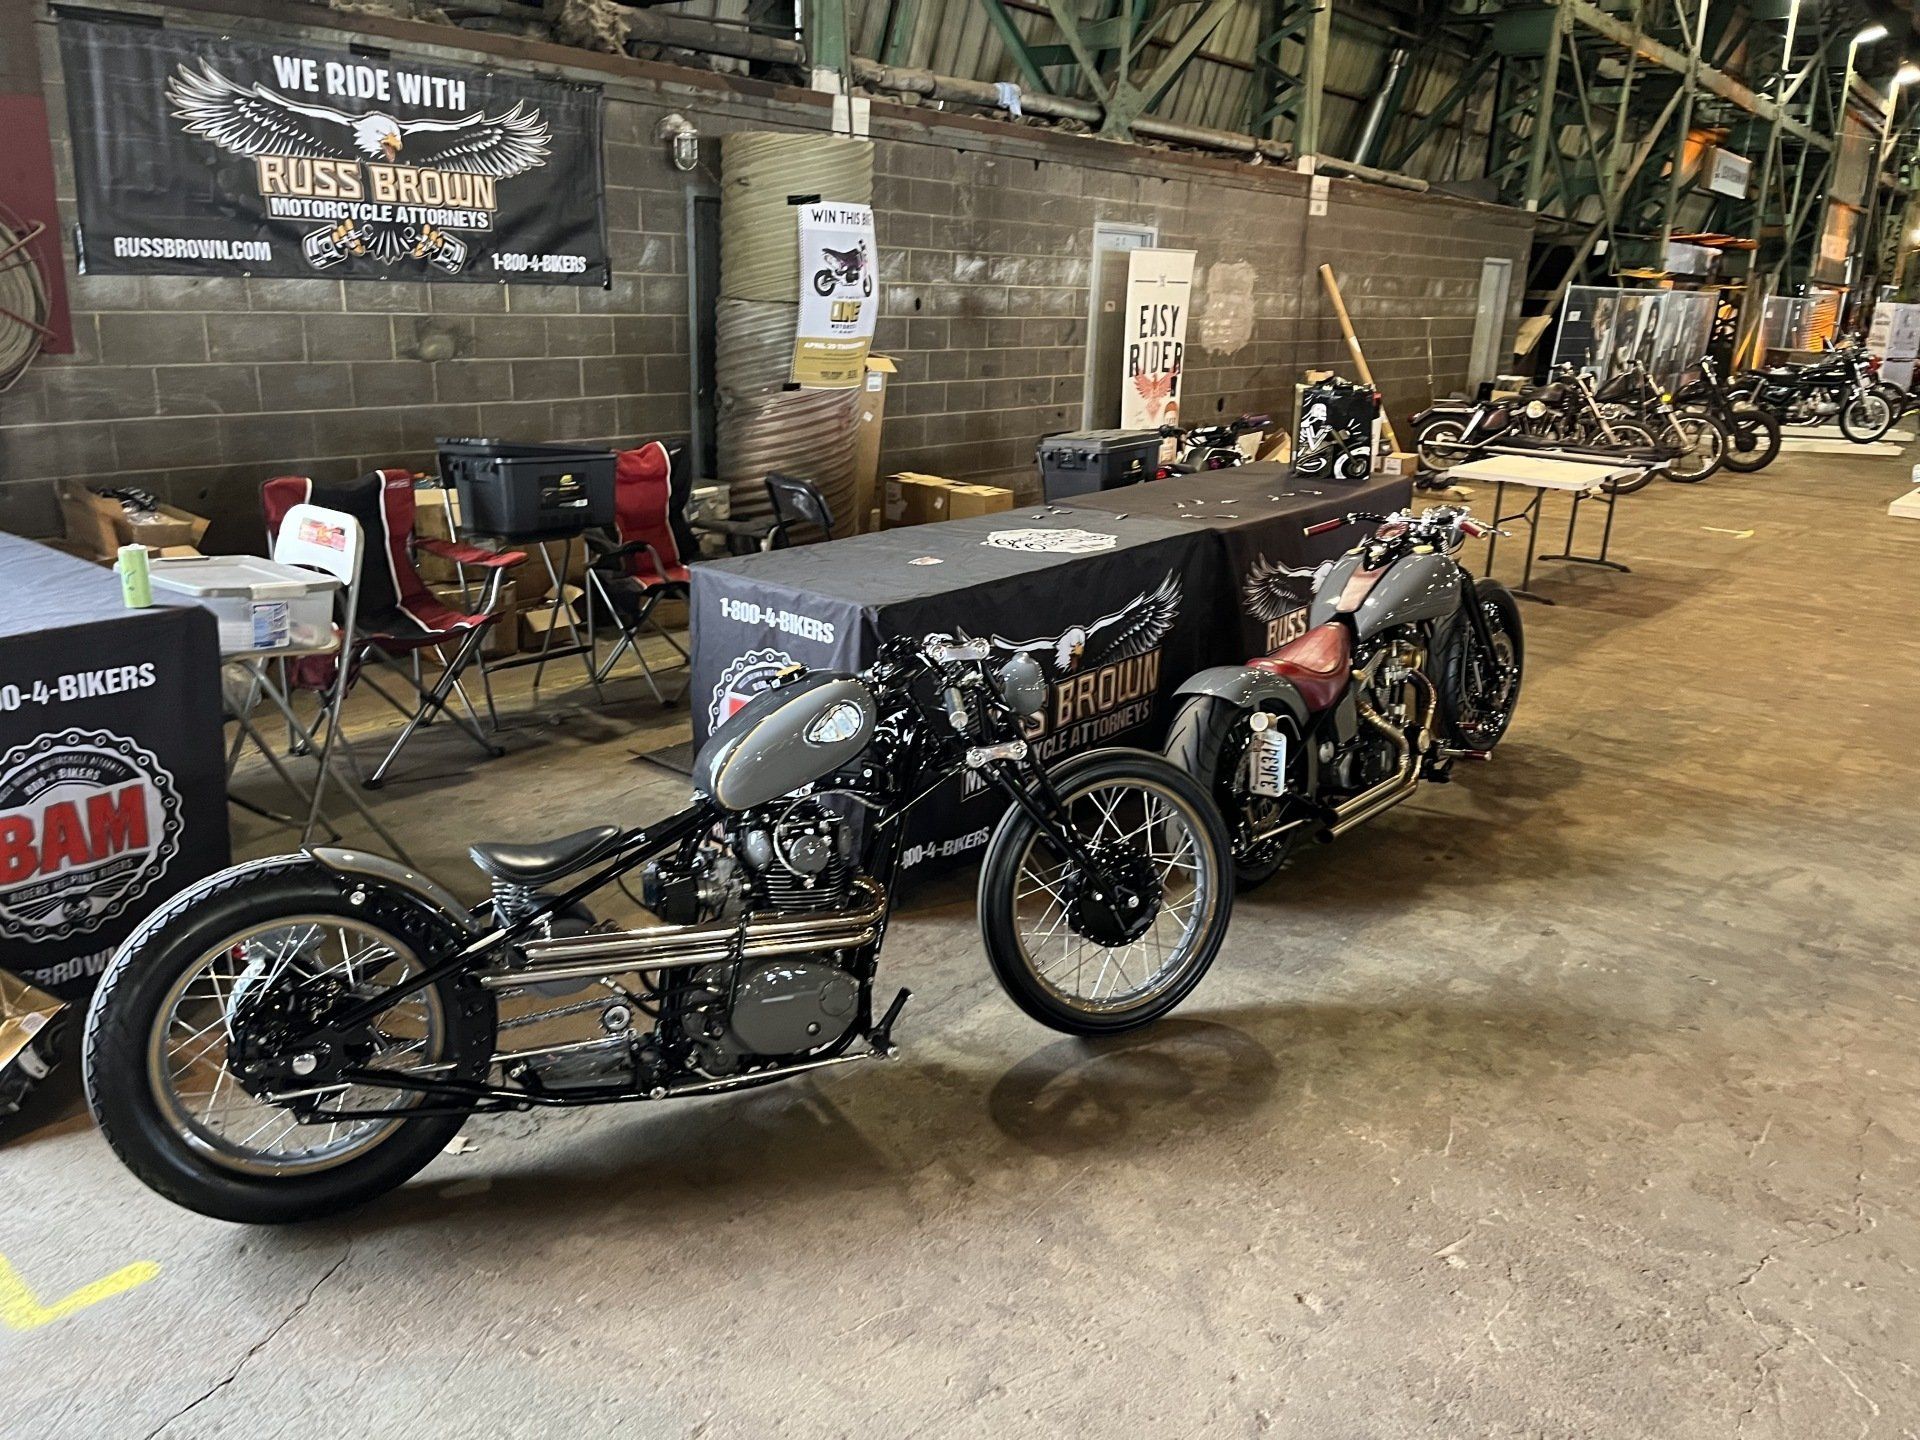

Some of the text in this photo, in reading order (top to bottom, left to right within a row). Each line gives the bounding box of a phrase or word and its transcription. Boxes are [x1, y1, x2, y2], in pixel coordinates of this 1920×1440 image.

[273, 55, 466, 111] WE RIDE WITH
[258, 155, 496, 211] RUSS BROWN
[270, 196, 489, 229] MOTORCYCLE ATTORNEYS
[811, 209, 837, 224] WIN
[840, 210, 861, 225] THIS
[113, 236, 273, 262] RUSSBROWN.COM
[491, 252, 587, 274] 1-800-4-BIKERS
[1139, 304, 1180, 339] EASY
[1129, 341, 1183, 378] RIDER
[719, 597, 835, 644] 1-800-4-BIKERS
[1266, 607, 1307, 652] RUSS
[0, 662, 157, 712] 0-4-BIKERS
[1057, 650, 1162, 727] BROWN
[1070, 702, 1150, 751] ATTORNEYS
